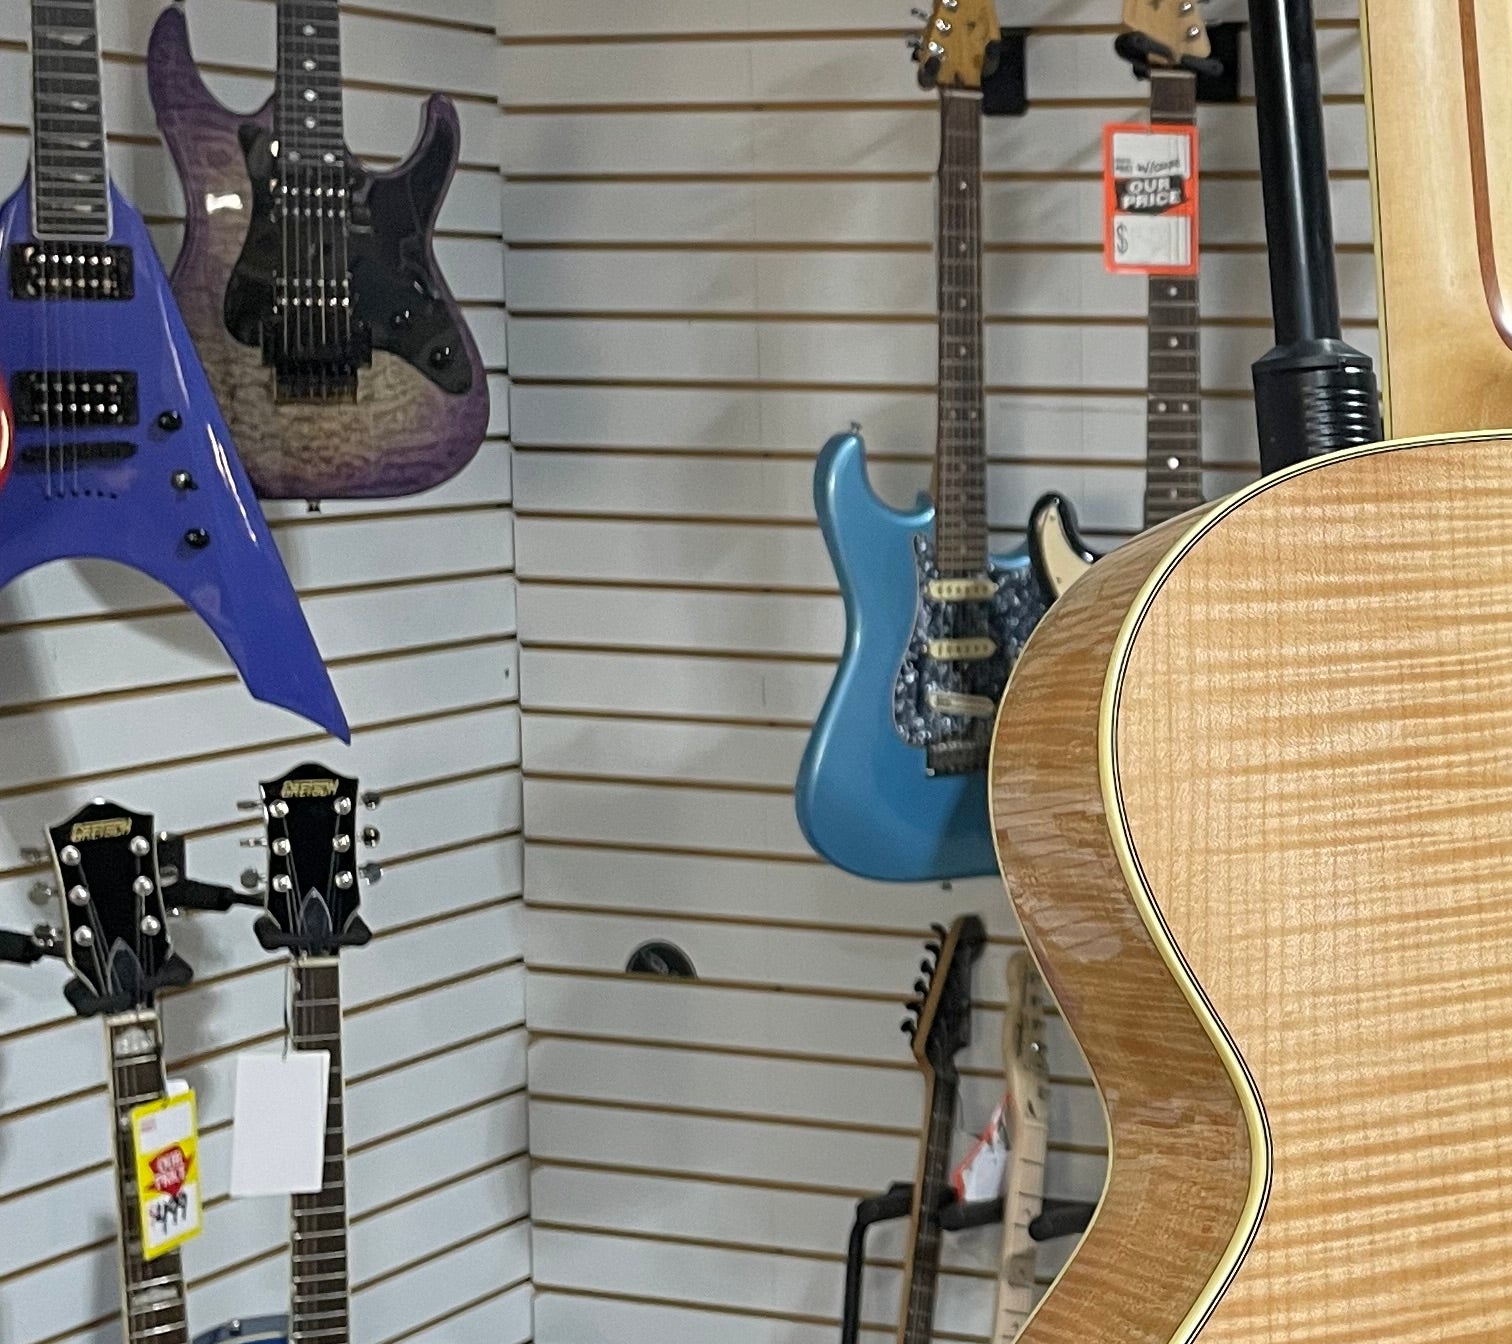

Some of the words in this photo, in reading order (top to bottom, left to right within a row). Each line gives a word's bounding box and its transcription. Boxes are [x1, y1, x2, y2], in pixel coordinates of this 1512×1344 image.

[1128, 177, 1171, 194] OUR
[1122, 188, 1182, 210] PRICE
[281, 778, 340, 799] GRETSCH
[70, 817, 133, 843] GRETSCH
